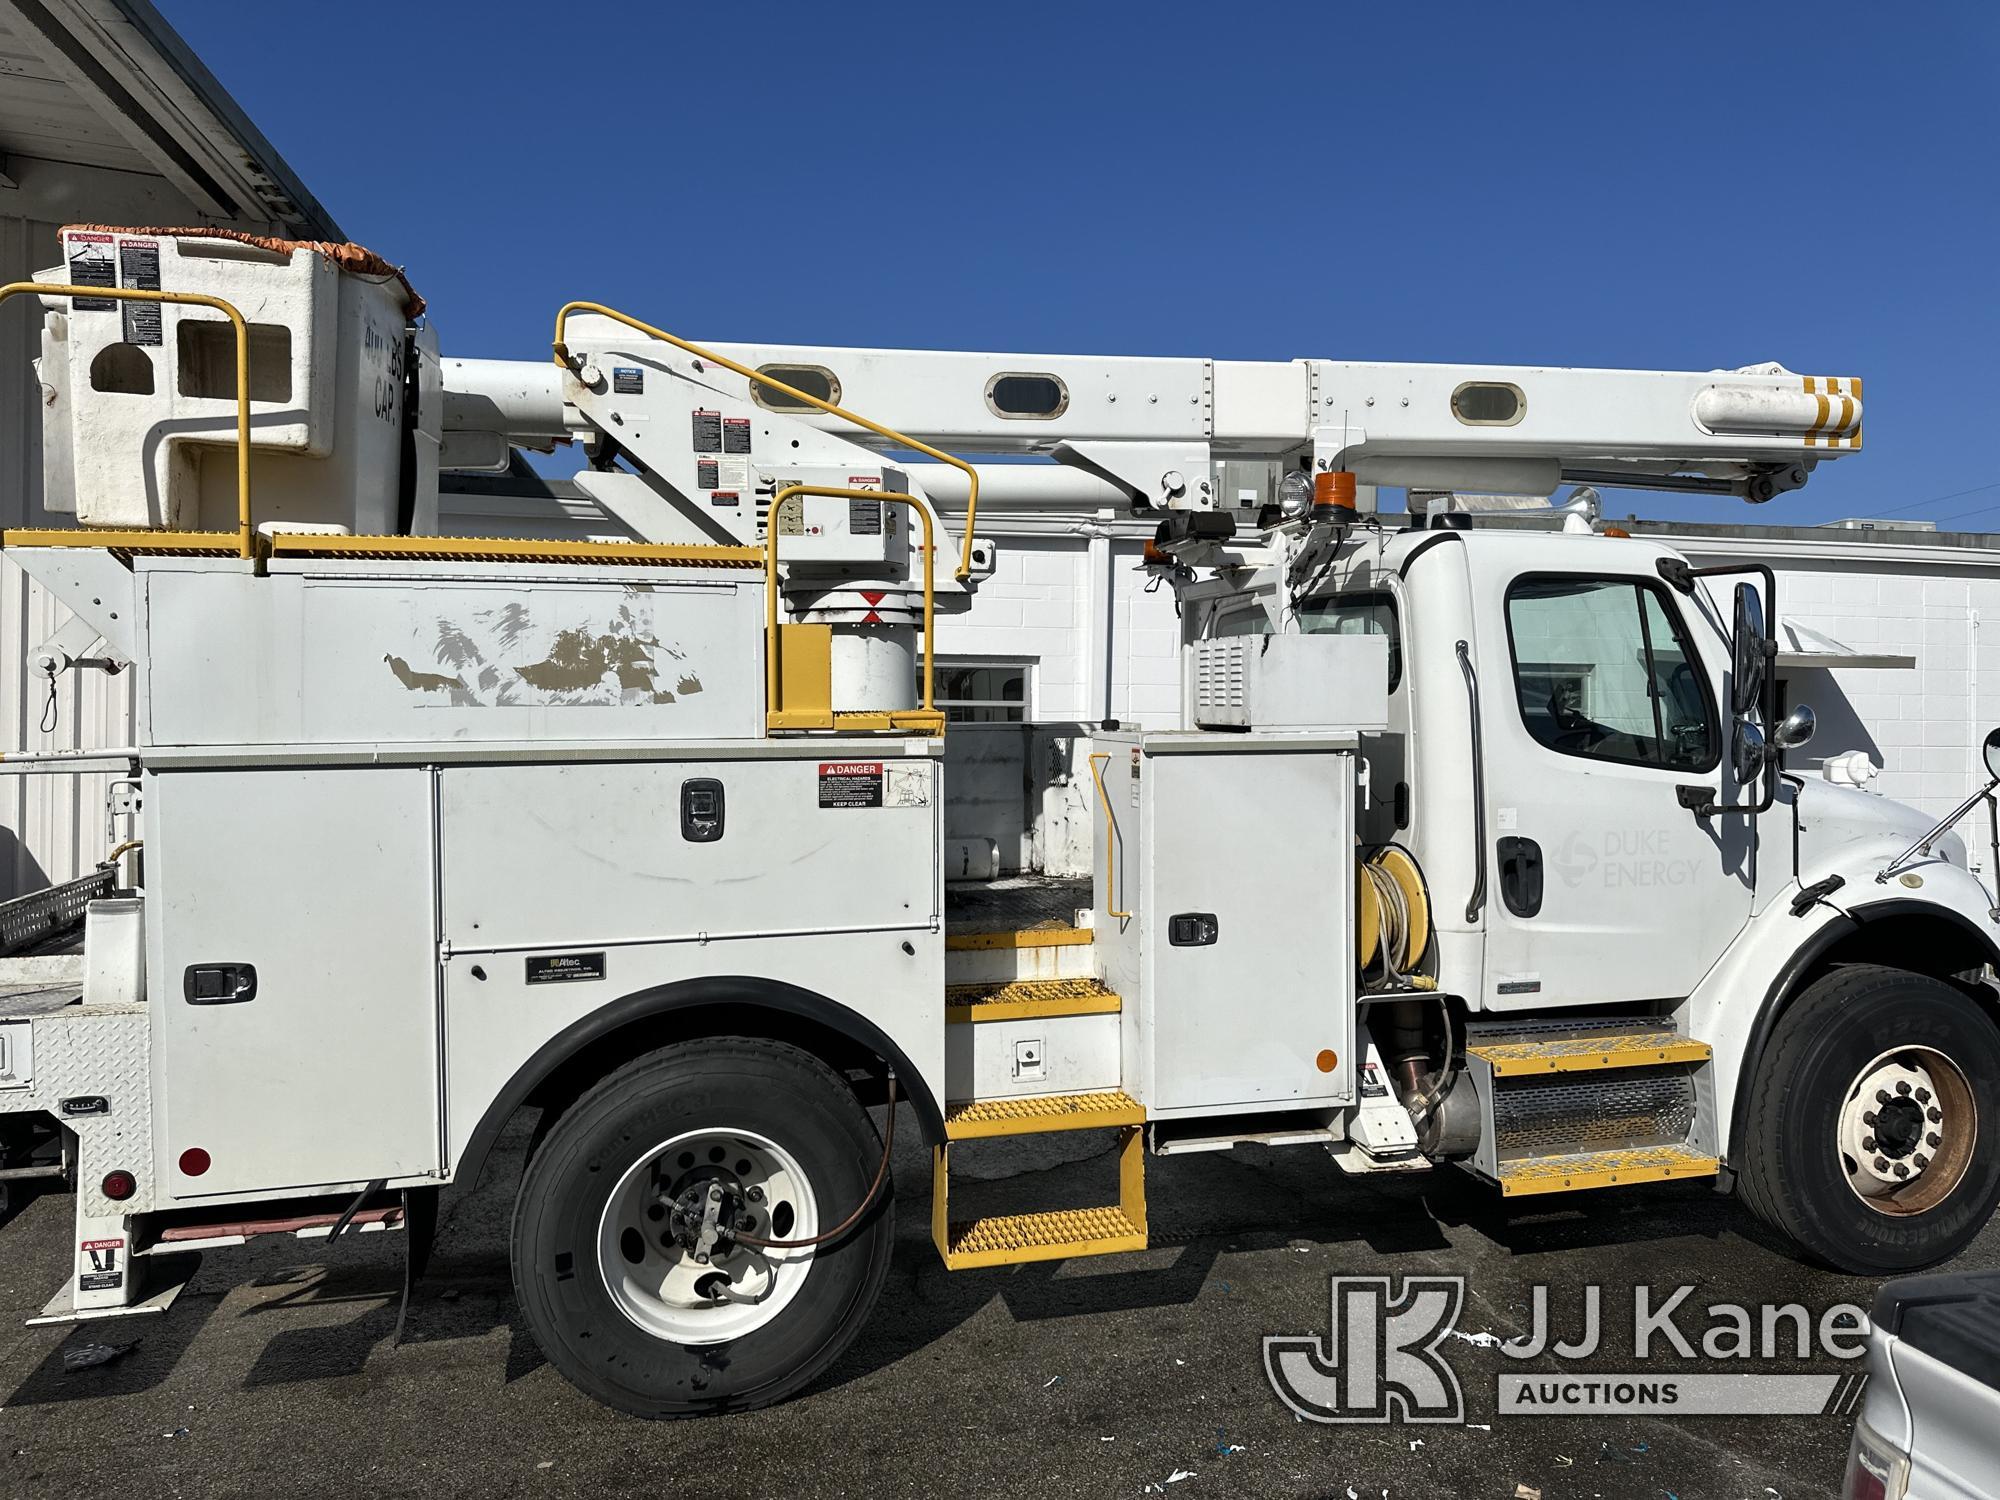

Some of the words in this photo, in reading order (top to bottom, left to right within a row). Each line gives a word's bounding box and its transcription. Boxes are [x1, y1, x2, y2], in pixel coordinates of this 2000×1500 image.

[128, 241, 158, 249] DANGER
[836, 765, 876, 774] DANGER
[1605, 830, 1670, 856] DUKE
[1604, 860, 1702, 888] ENERGY
[560, 958, 580, 967] Altec
[94, 1241, 121, 1249] DANGER
